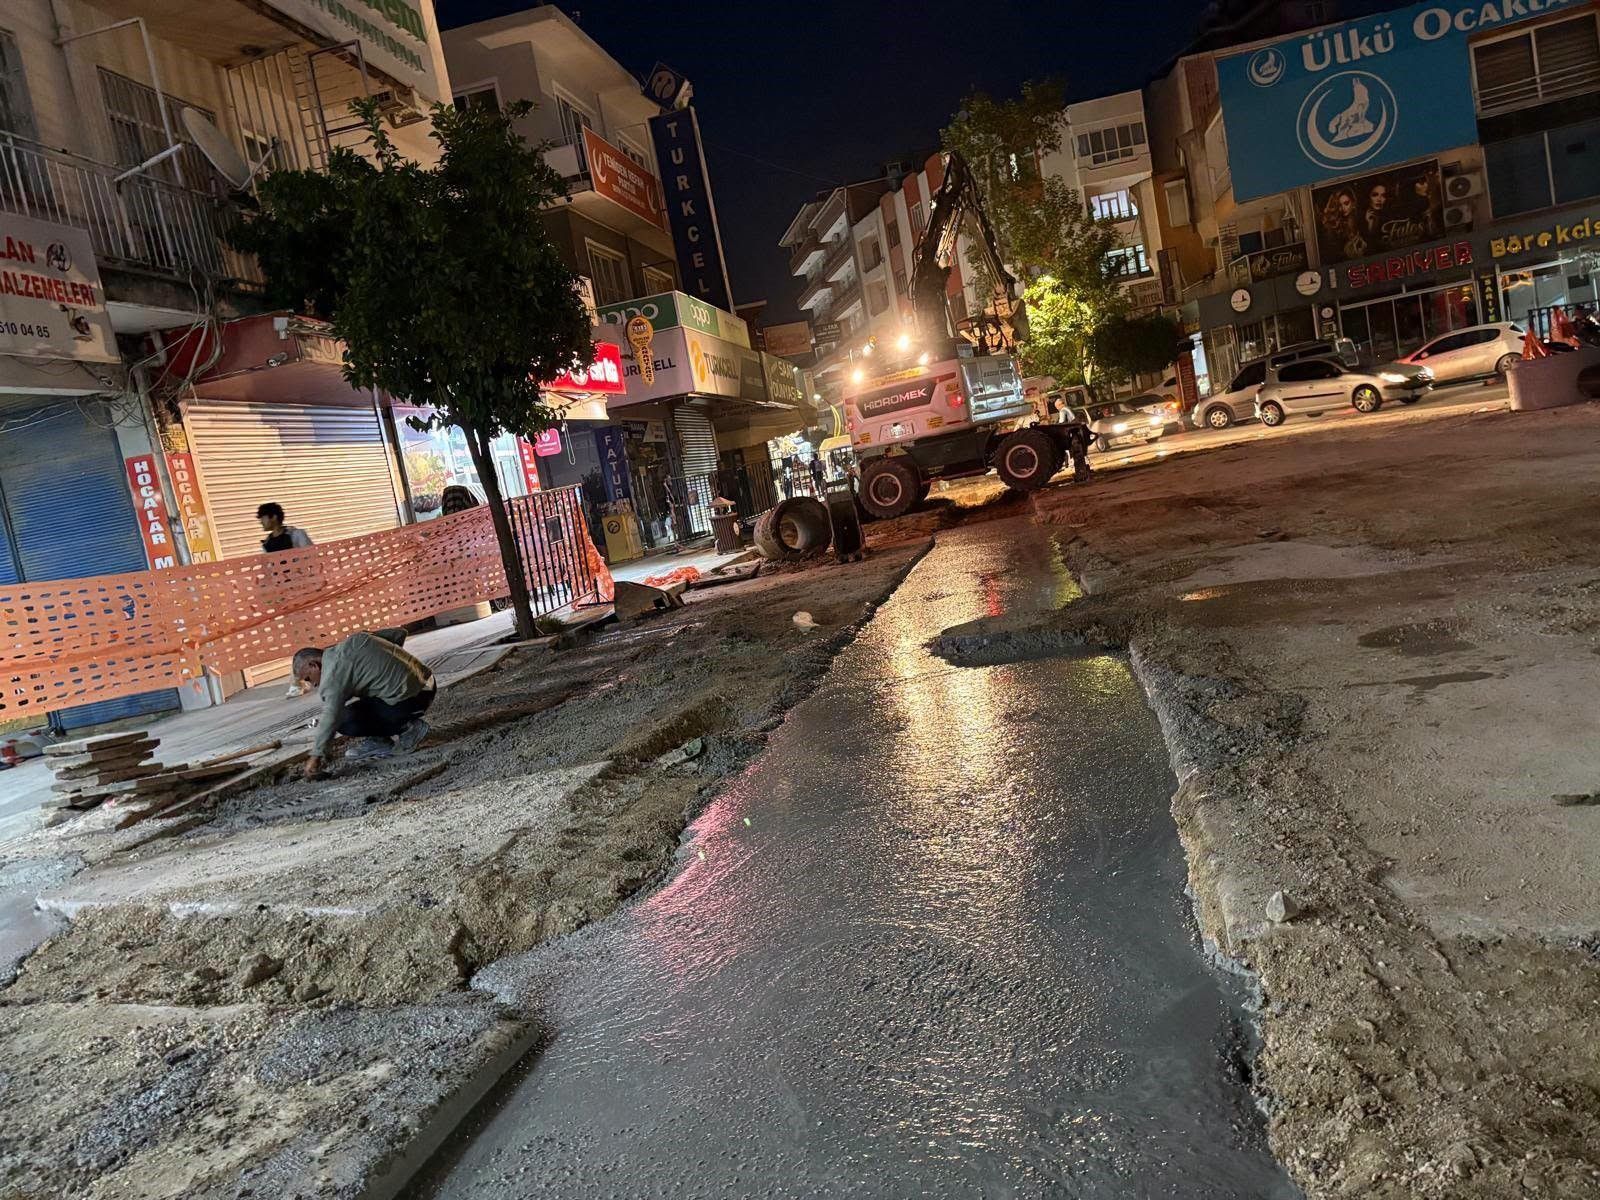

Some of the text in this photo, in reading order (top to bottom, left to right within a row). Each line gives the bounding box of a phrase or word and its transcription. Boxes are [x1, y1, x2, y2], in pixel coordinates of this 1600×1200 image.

[1301, 22, 1395, 72] Ülkü
[1346, 240, 1473, 288] SARIYER
[20, 323, 34, 336] 04
[36, 325, 50, 338] 85
[133, 460, 166, 545] HOCALAR
[171, 458, 203, 539] HOCALAR
